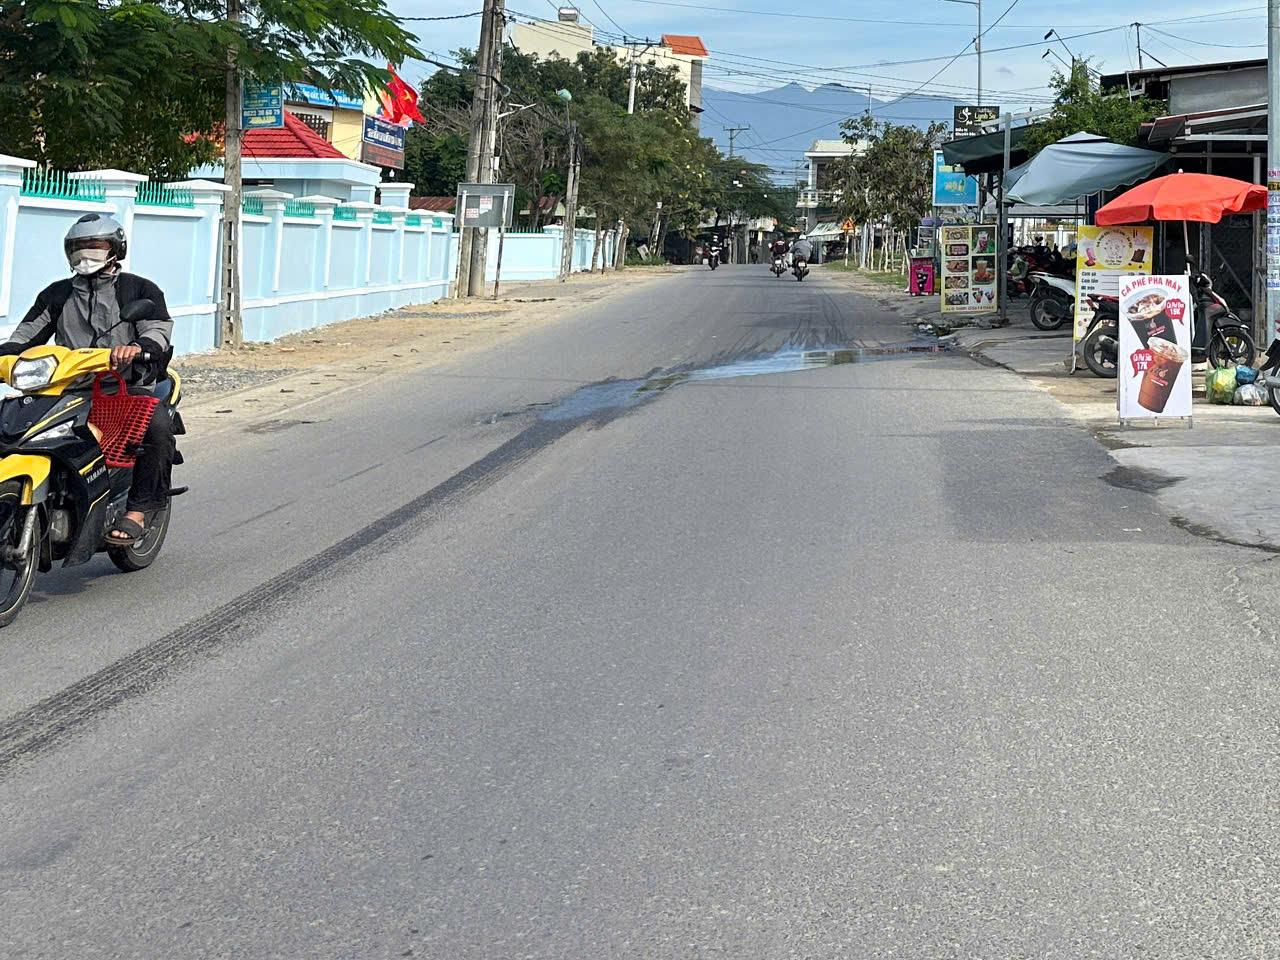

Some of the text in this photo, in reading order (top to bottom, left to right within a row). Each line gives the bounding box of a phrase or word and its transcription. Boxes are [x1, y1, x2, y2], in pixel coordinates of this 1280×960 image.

[1132, 277, 1146, 290] PHÊ
[1148, 277, 1162, 285] PHA
[86, 465, 106, 484] YAMAHA
